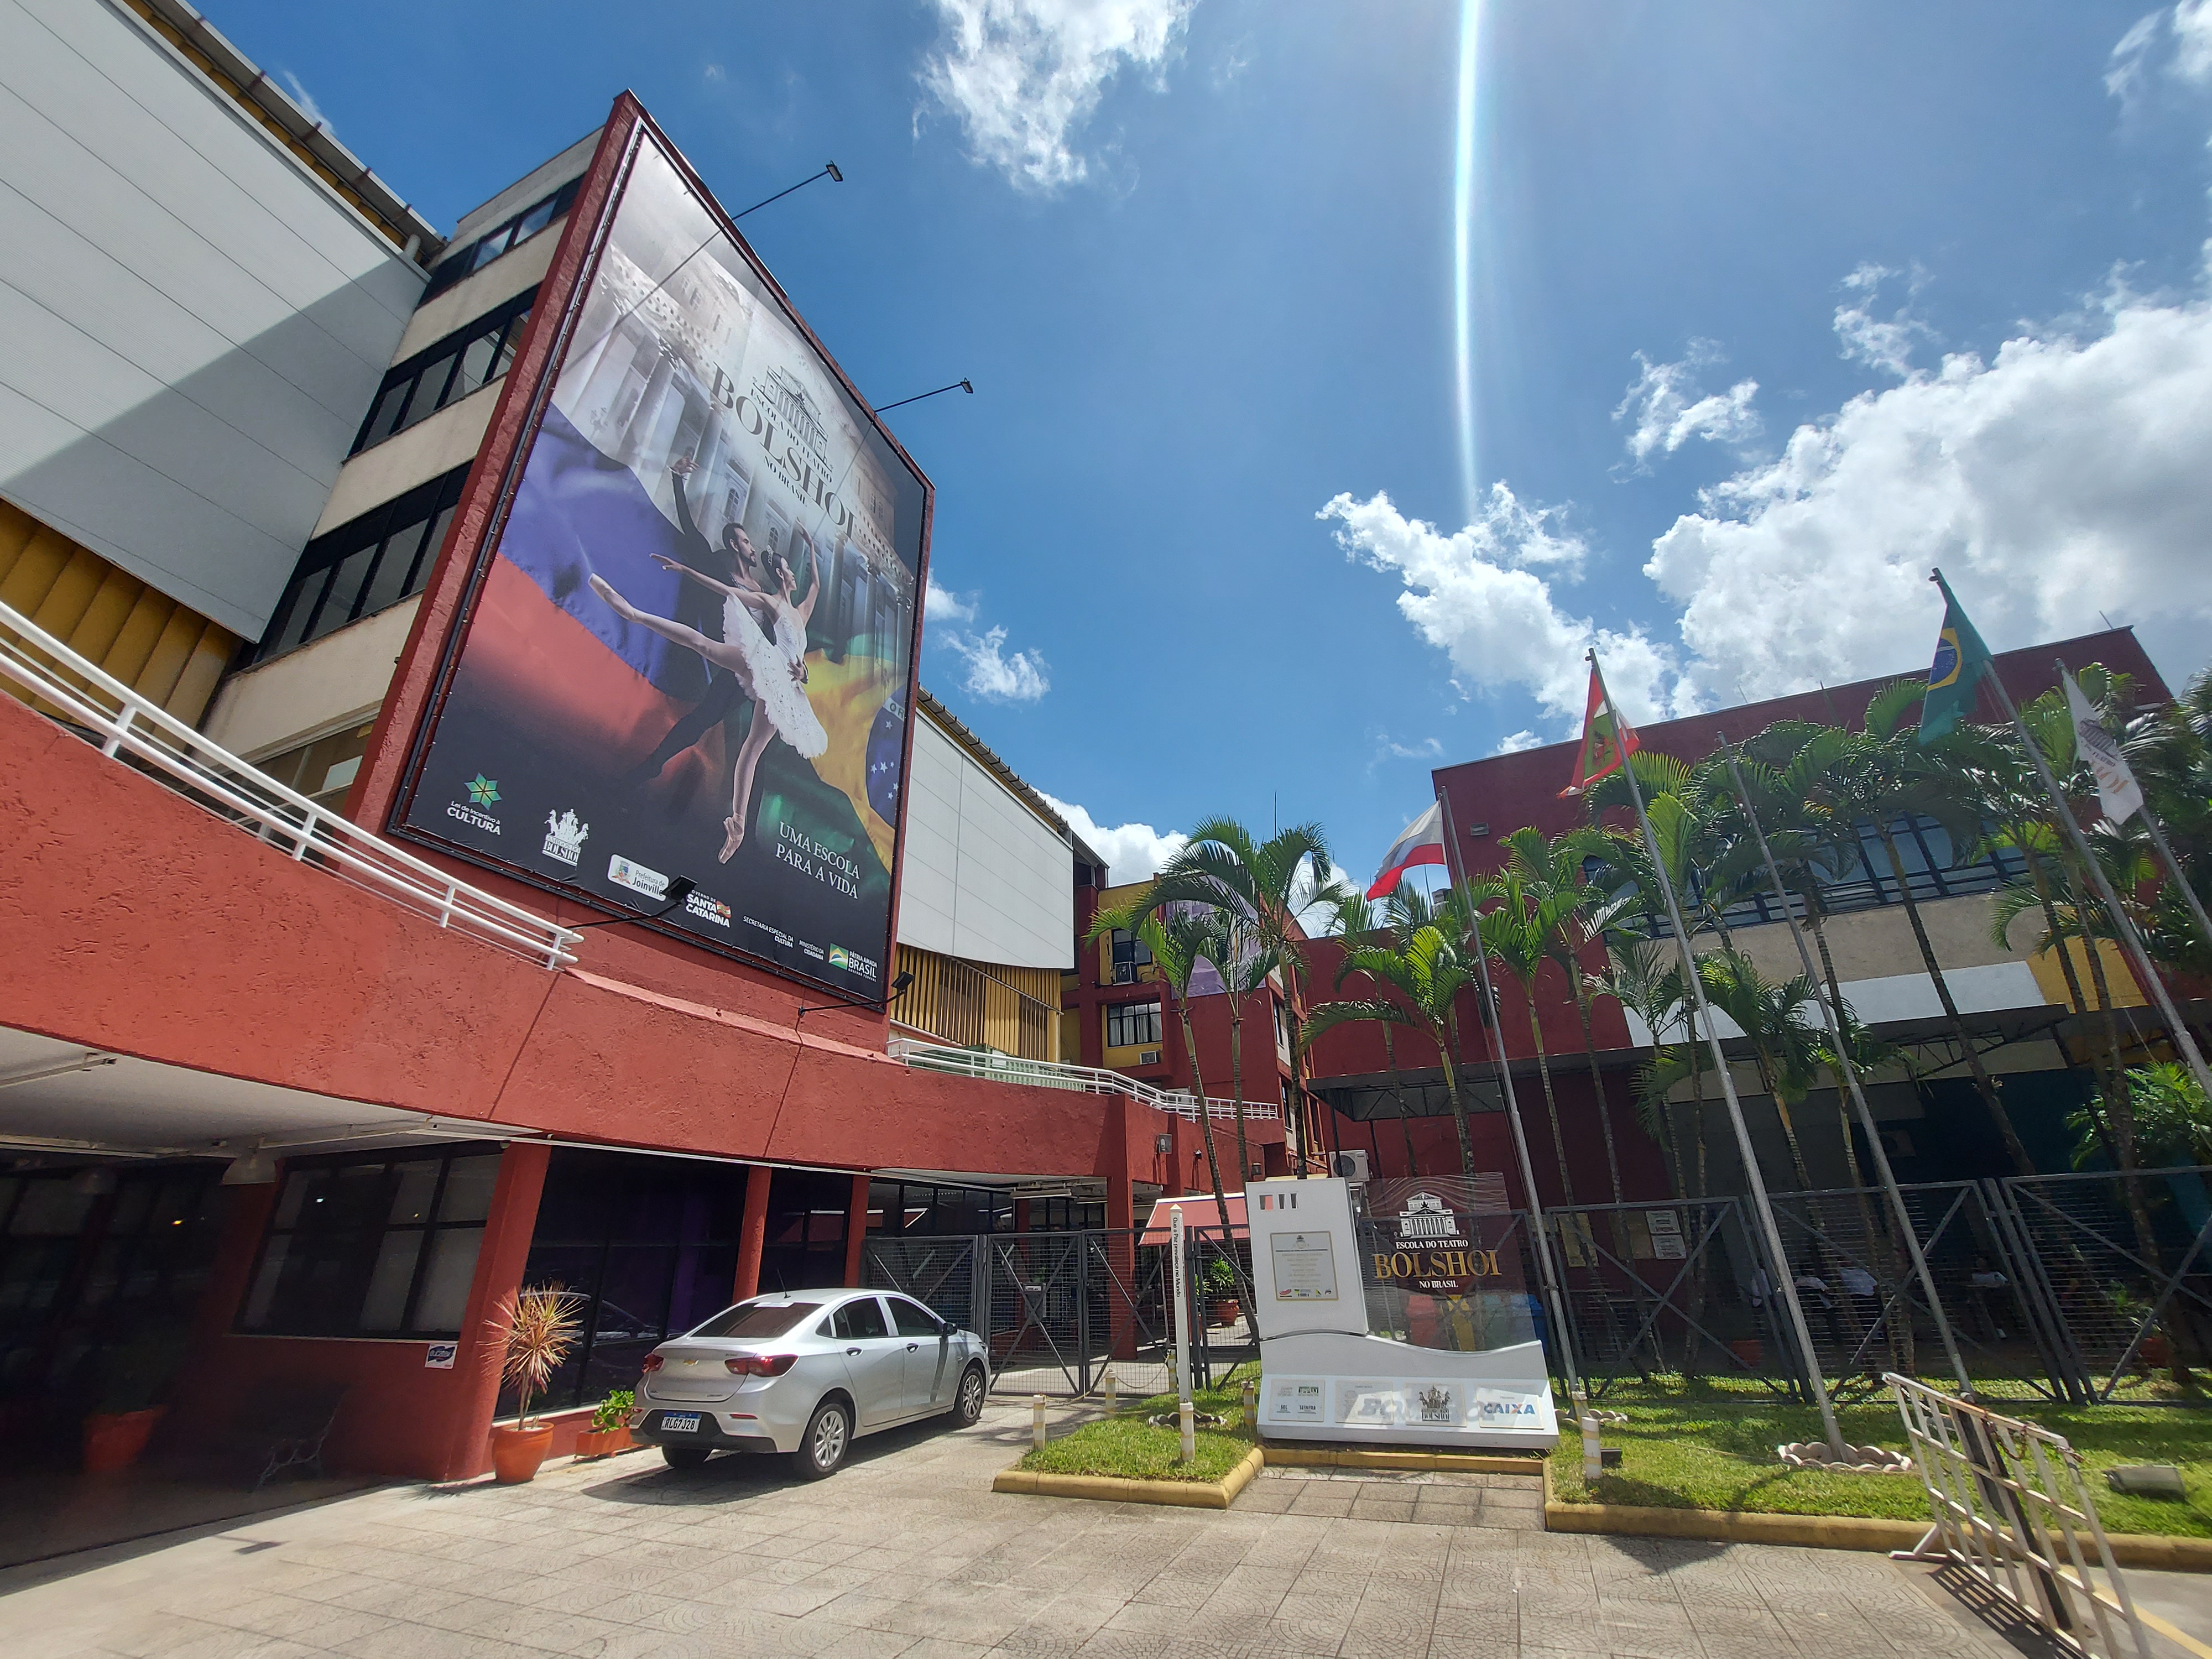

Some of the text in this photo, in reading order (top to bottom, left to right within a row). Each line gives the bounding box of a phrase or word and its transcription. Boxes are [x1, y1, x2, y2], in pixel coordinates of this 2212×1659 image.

[750, 388, 832, 483] ESCOLA DO TEATRO
[708, 361, 857, 542] BOLSHOI
[765, 456, 807, 507] NO BRASIL
[447, 807, 501, 836] CULTURA
[470, 808, 496, 823] Incentivo
[543, 841, 579, 862] BOLSHOI
[780, 821, 860, 880] UMA ESCOLA
[635, 870, 659, 884] Prefeitura
[775, 842, 858, 899] PARA A VIDA
[632, 877, 663, 896] Joinville
[691, 890, 710, 900] OVERNO
[686, 894, 717, 913] SANTA
[686, 903, 730, 928] CATARINA
[743, 916, 768, 931] SECRETARIA
[769, 926, 787, 940] ESPECIAL
[774, 936, 794, 948] CULTURA
[799, 940, 819, 953] MINISTÉRIO
[804, 948, 824, 961] CIDADANIA
[849, 951, 878, 968] PÁTRIA AMADA
[848, 959, 877, 978] BRASIL
[1395, 1241, 1425, 1249] ESCOLA
[1437, 1239, 1469, 1248] TEATRO
[1371, 1249, 1503, 1279] BOLSHOI
[1419, 1280, 1459, 1288] NO BRASIL
[1484, 1403, 1536, 1415] CAIXA
[664, 1418, 695, 1430] RLG7J28
